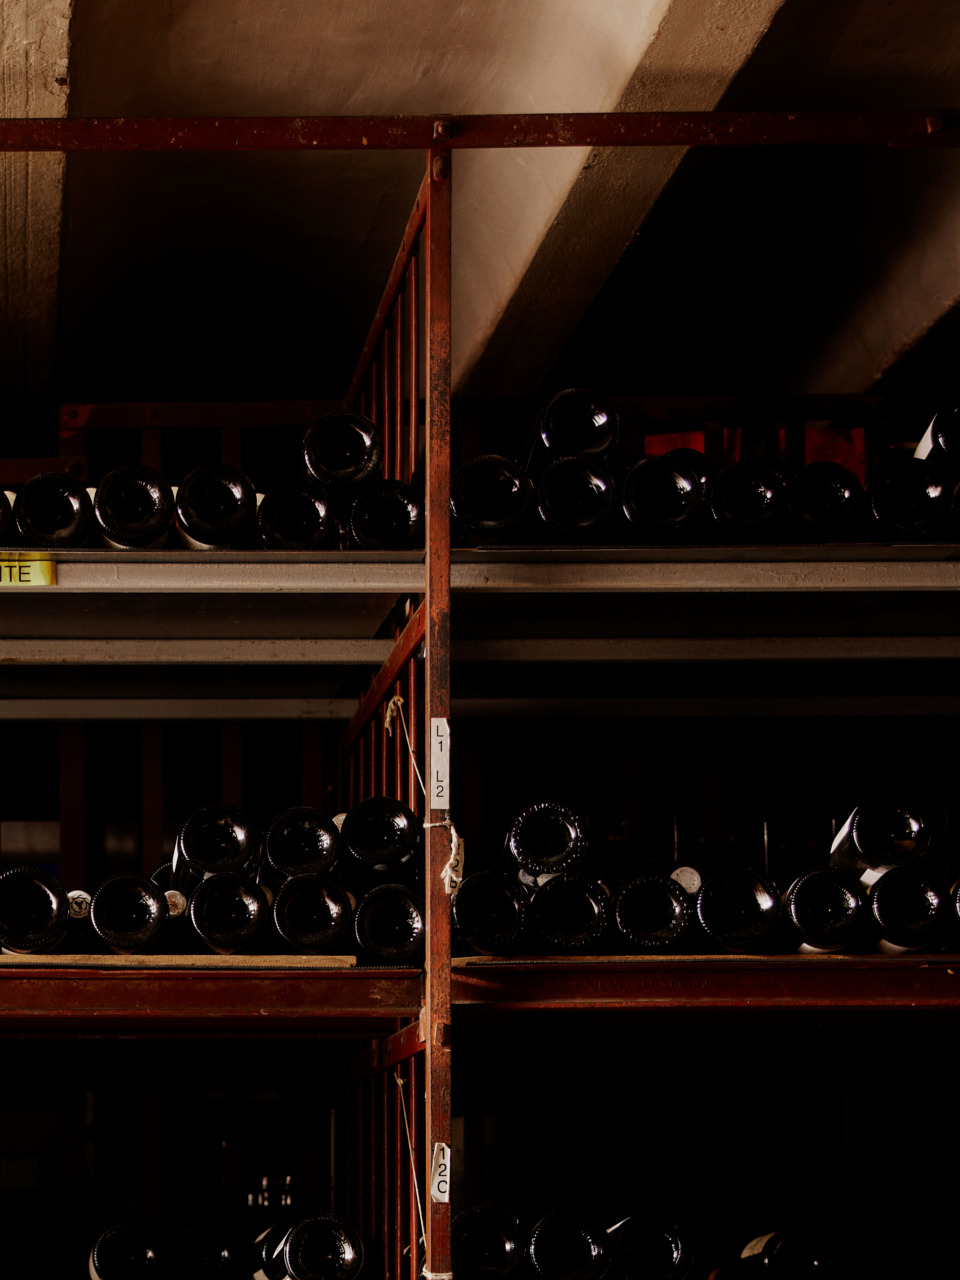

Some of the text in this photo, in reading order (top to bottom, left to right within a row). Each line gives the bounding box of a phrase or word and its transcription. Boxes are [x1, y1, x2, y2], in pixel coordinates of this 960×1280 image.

[436, 725, 444, 798] L1 L2
[437, 1146, 448, 1194] 12C
